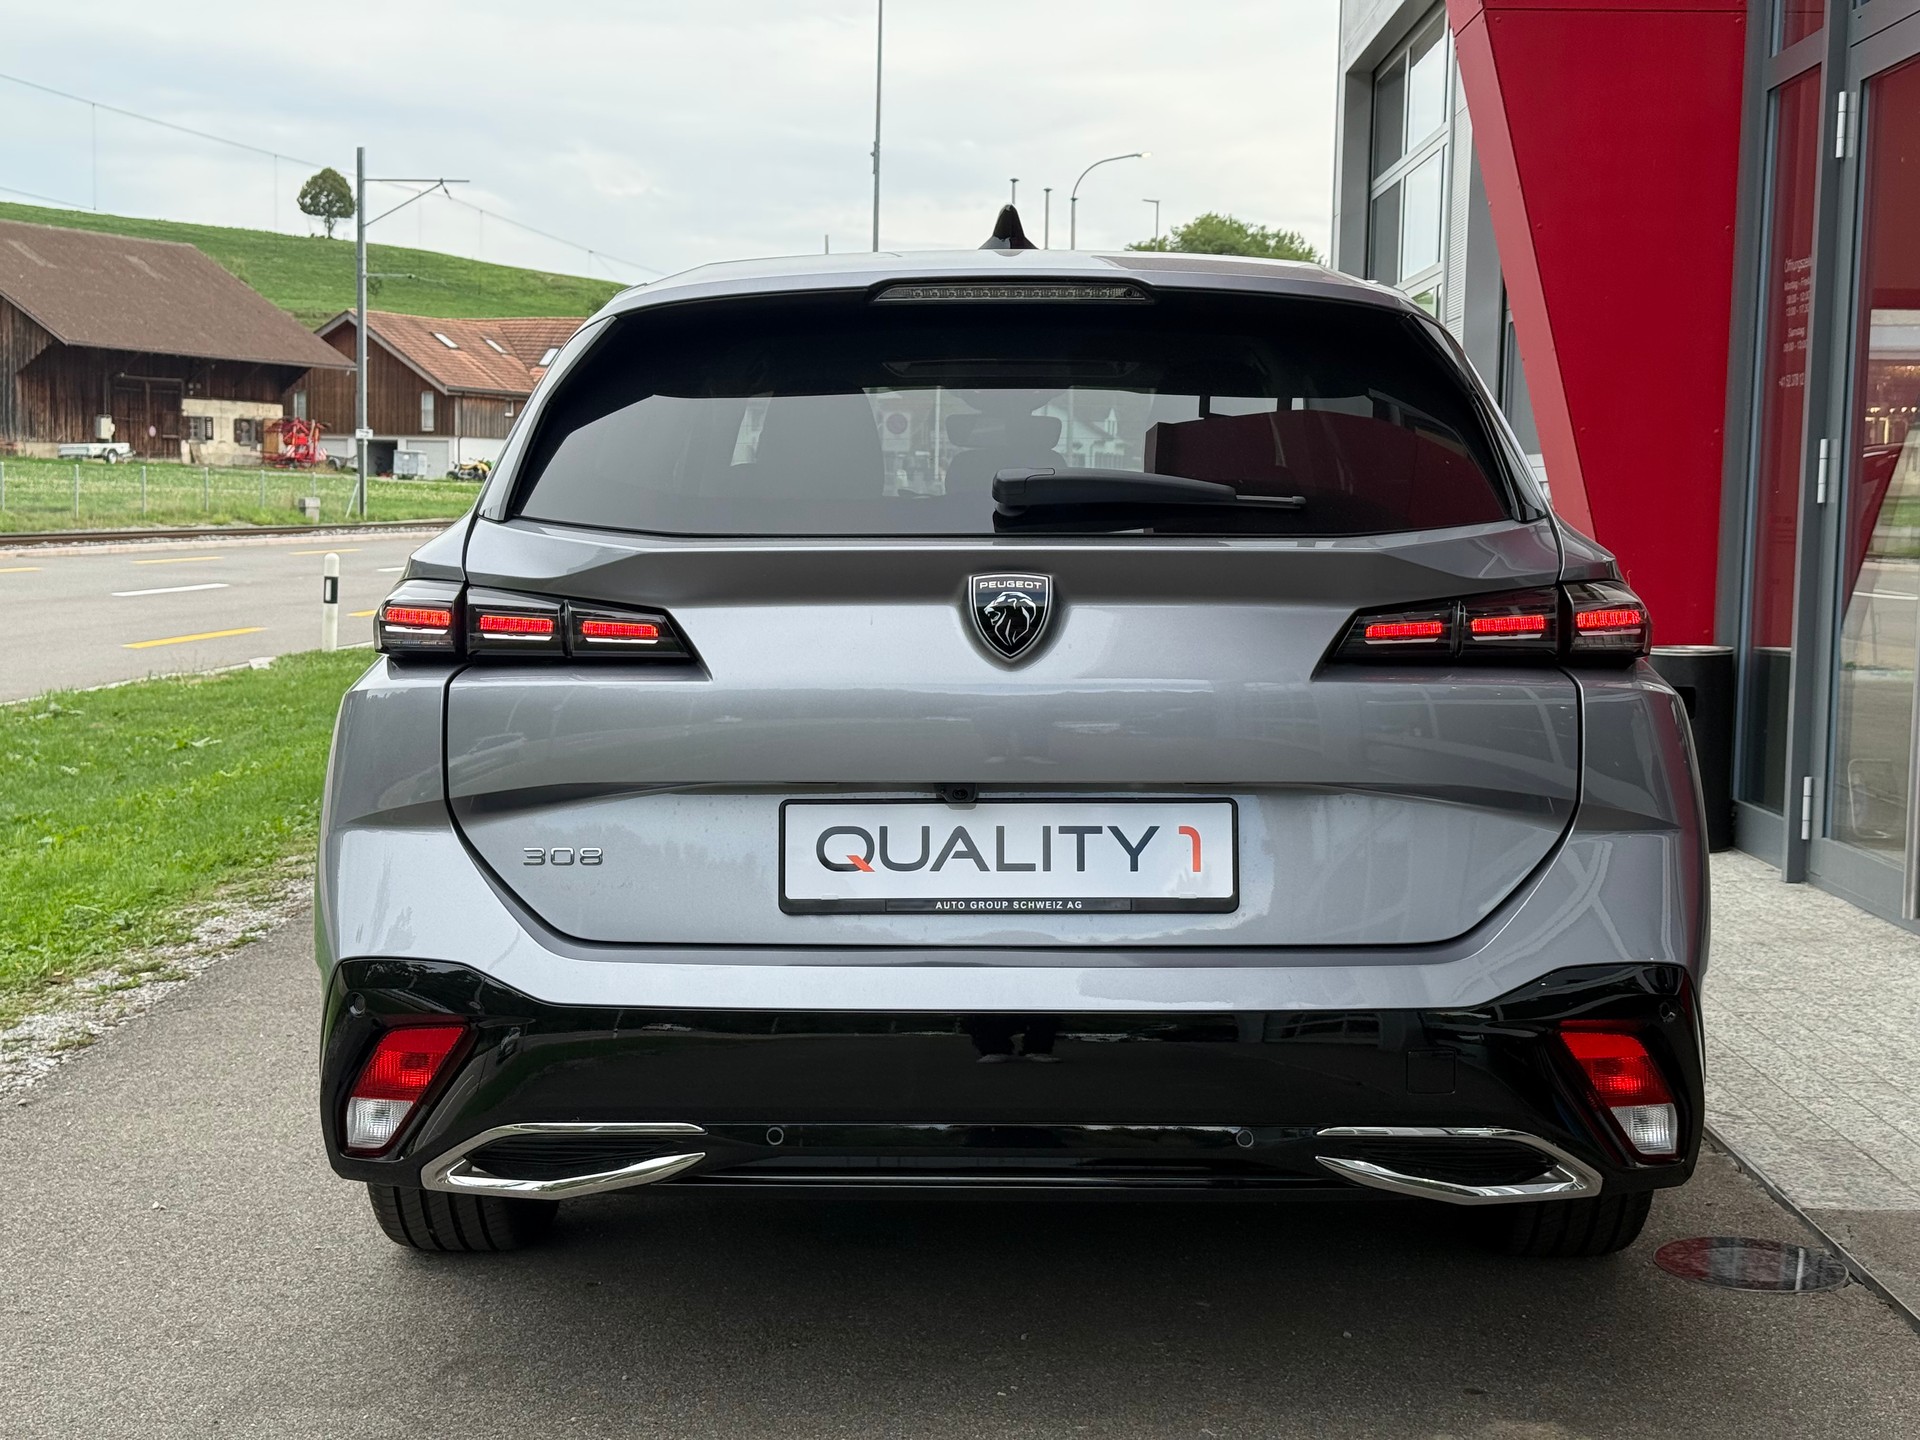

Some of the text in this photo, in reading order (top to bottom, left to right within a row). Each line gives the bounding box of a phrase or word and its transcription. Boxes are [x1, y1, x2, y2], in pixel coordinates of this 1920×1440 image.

[980, 580, 1042, 590] PEUGEOT
[815, 825, 1202, 873] QUALITY 1
[523, 847, 604, 866] 308
[935, 901, 1083, 909] AUTO GROUP SCHWEIZ AG
